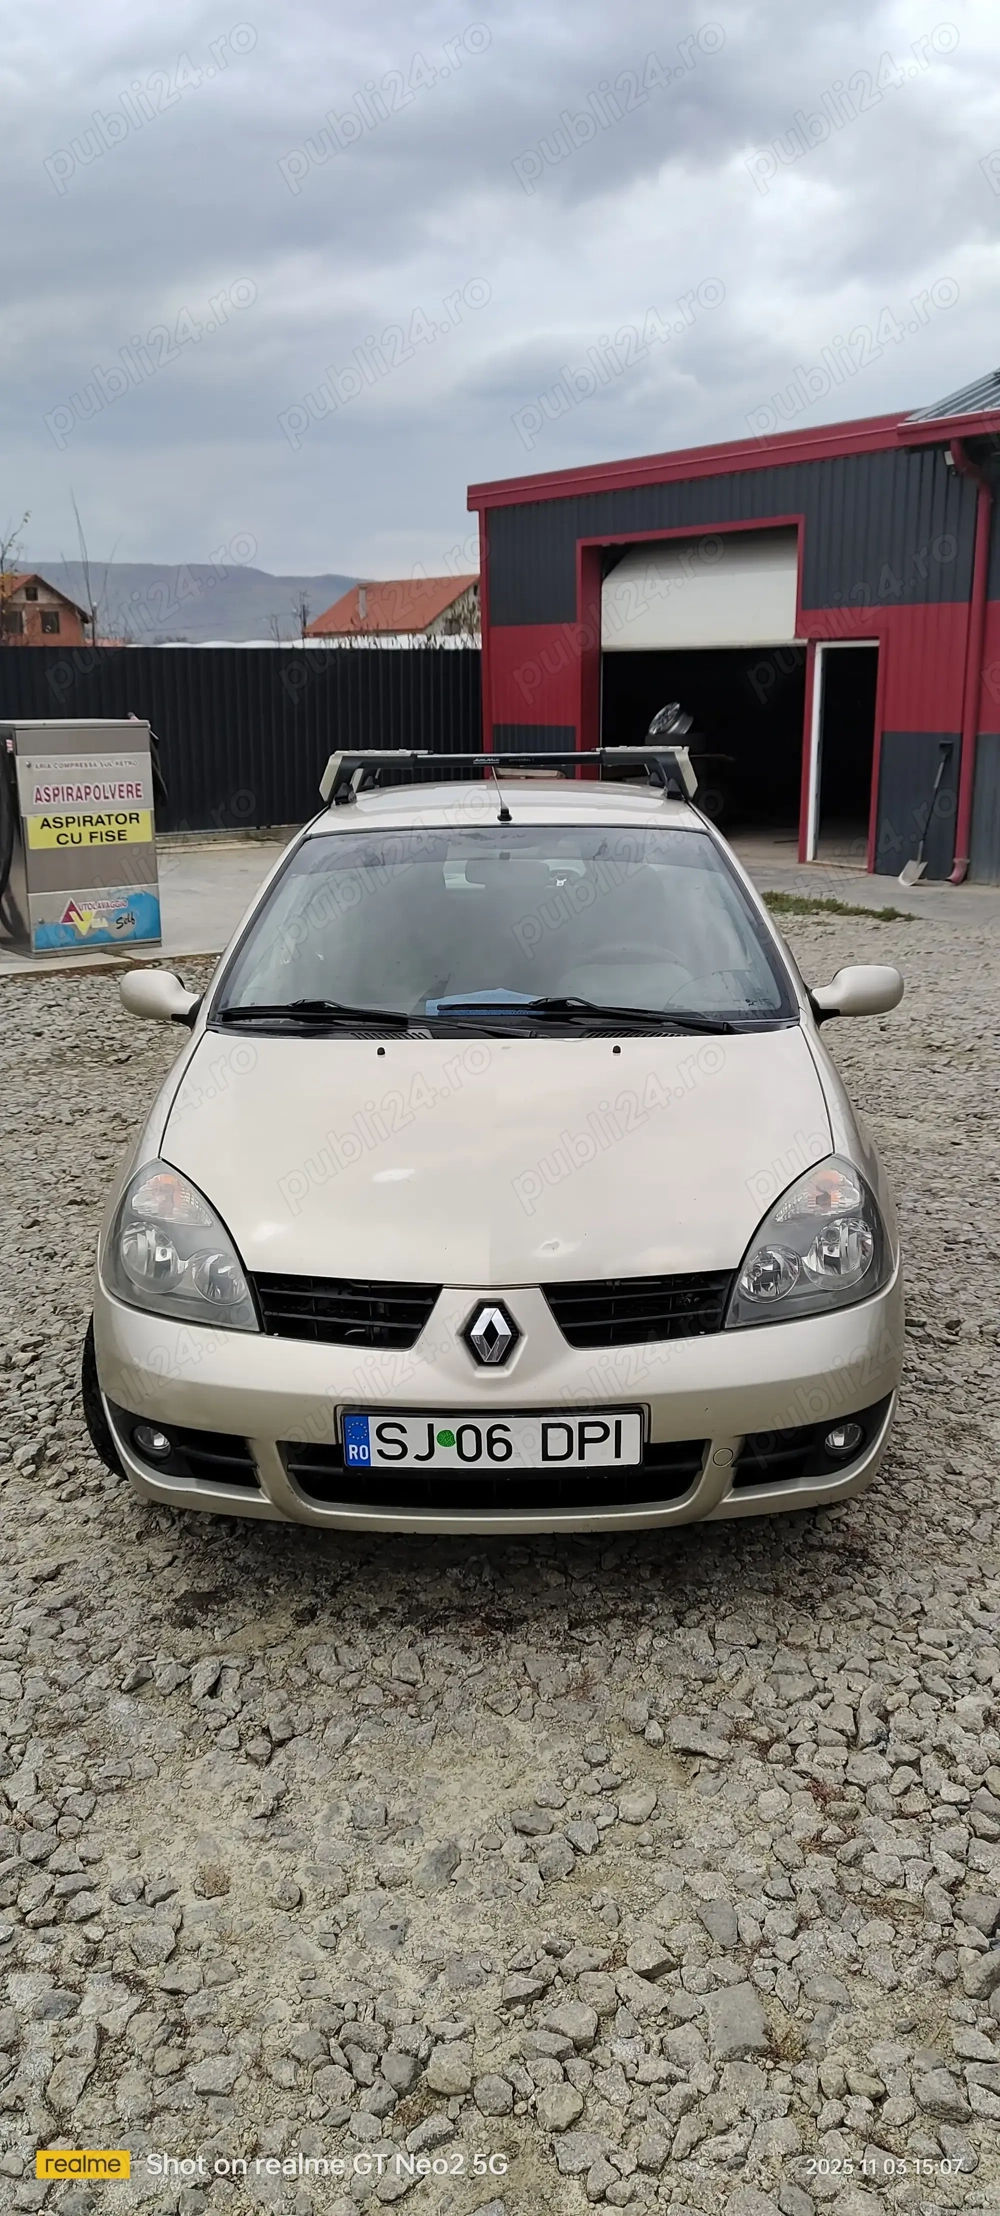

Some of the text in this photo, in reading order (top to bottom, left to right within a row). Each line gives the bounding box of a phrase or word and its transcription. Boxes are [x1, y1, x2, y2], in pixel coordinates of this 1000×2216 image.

[34, 782, 143, 803] ASPIRAPOLVERE
[40, 812, 140, 830] ASPIRATOR
[56, 830, 128, 845] CU FISE
[375, 1419, 622, 1462] SJ 06 DPI
[349, 1444, 369, 1461] RO
